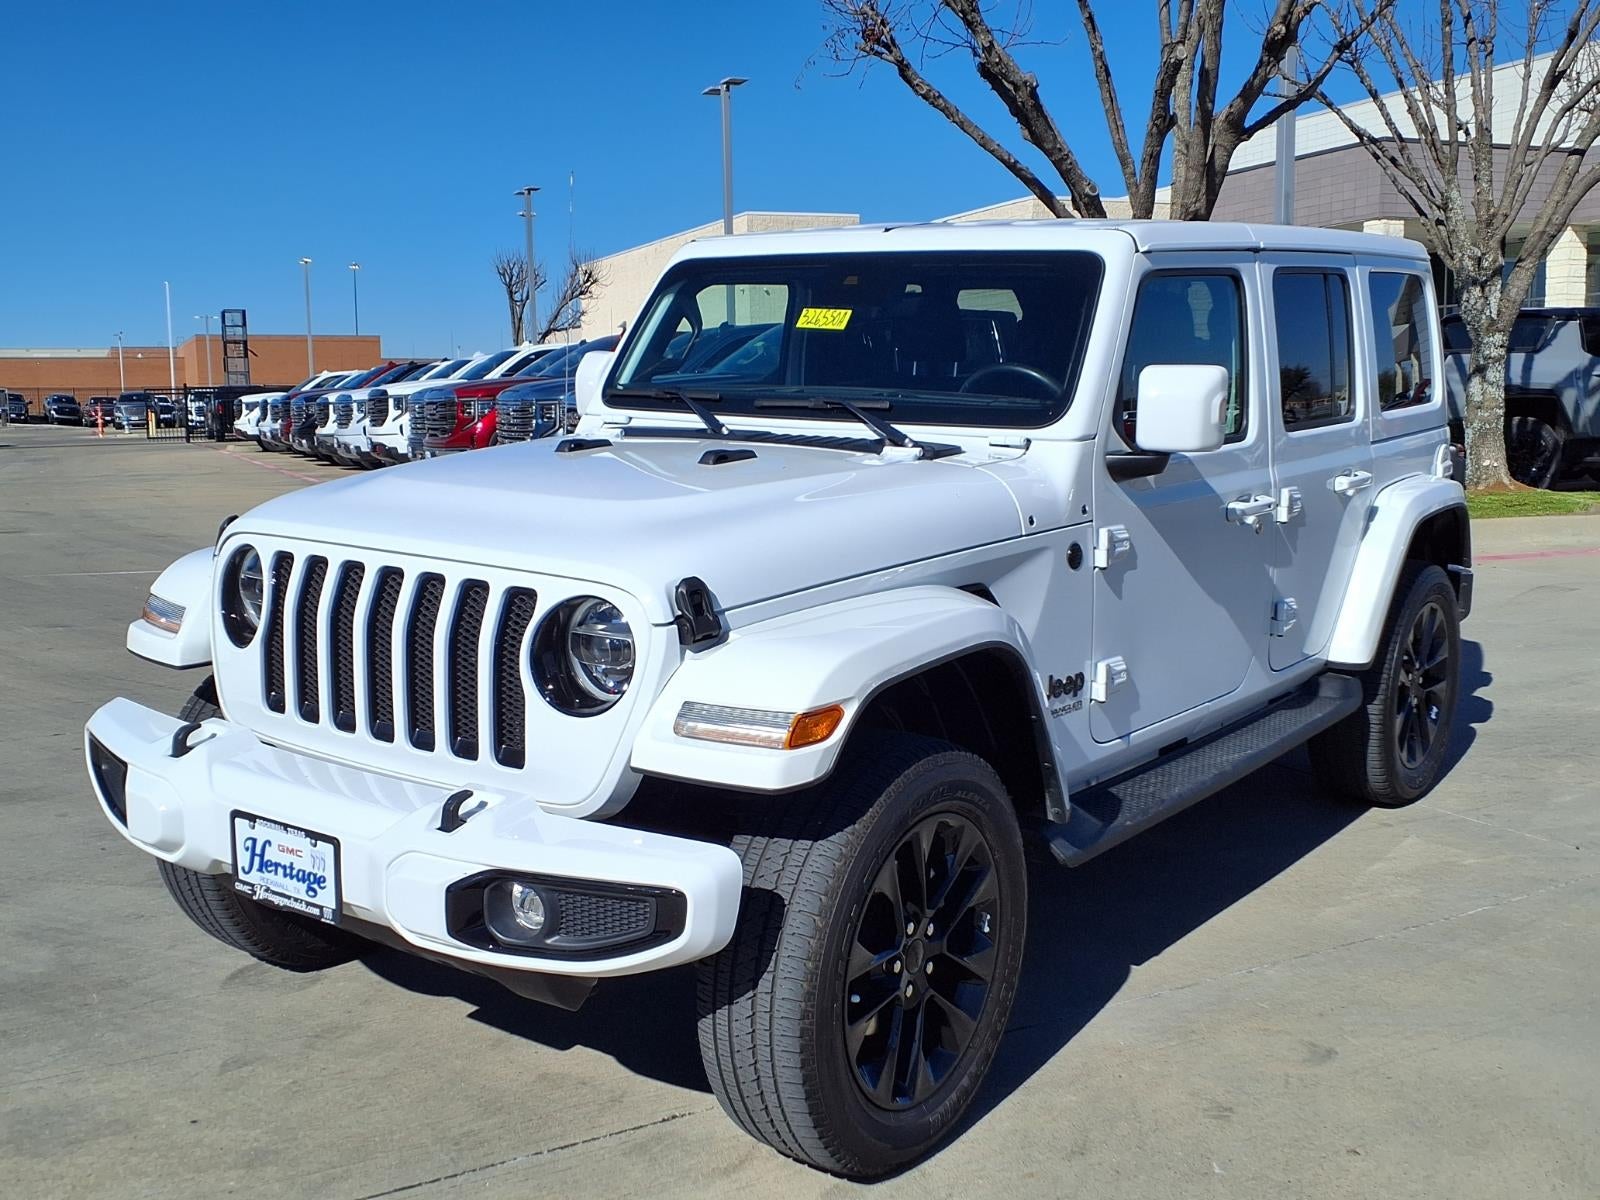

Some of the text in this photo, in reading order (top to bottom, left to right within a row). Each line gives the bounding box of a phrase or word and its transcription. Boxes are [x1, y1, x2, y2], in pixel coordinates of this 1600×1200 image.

[1047, 671, 1085, 701] Jeep
[277, 843, 303, 858] GMC
[241, 836, 327, 898] Heritage
[235, 882, 253, 894] GMC
